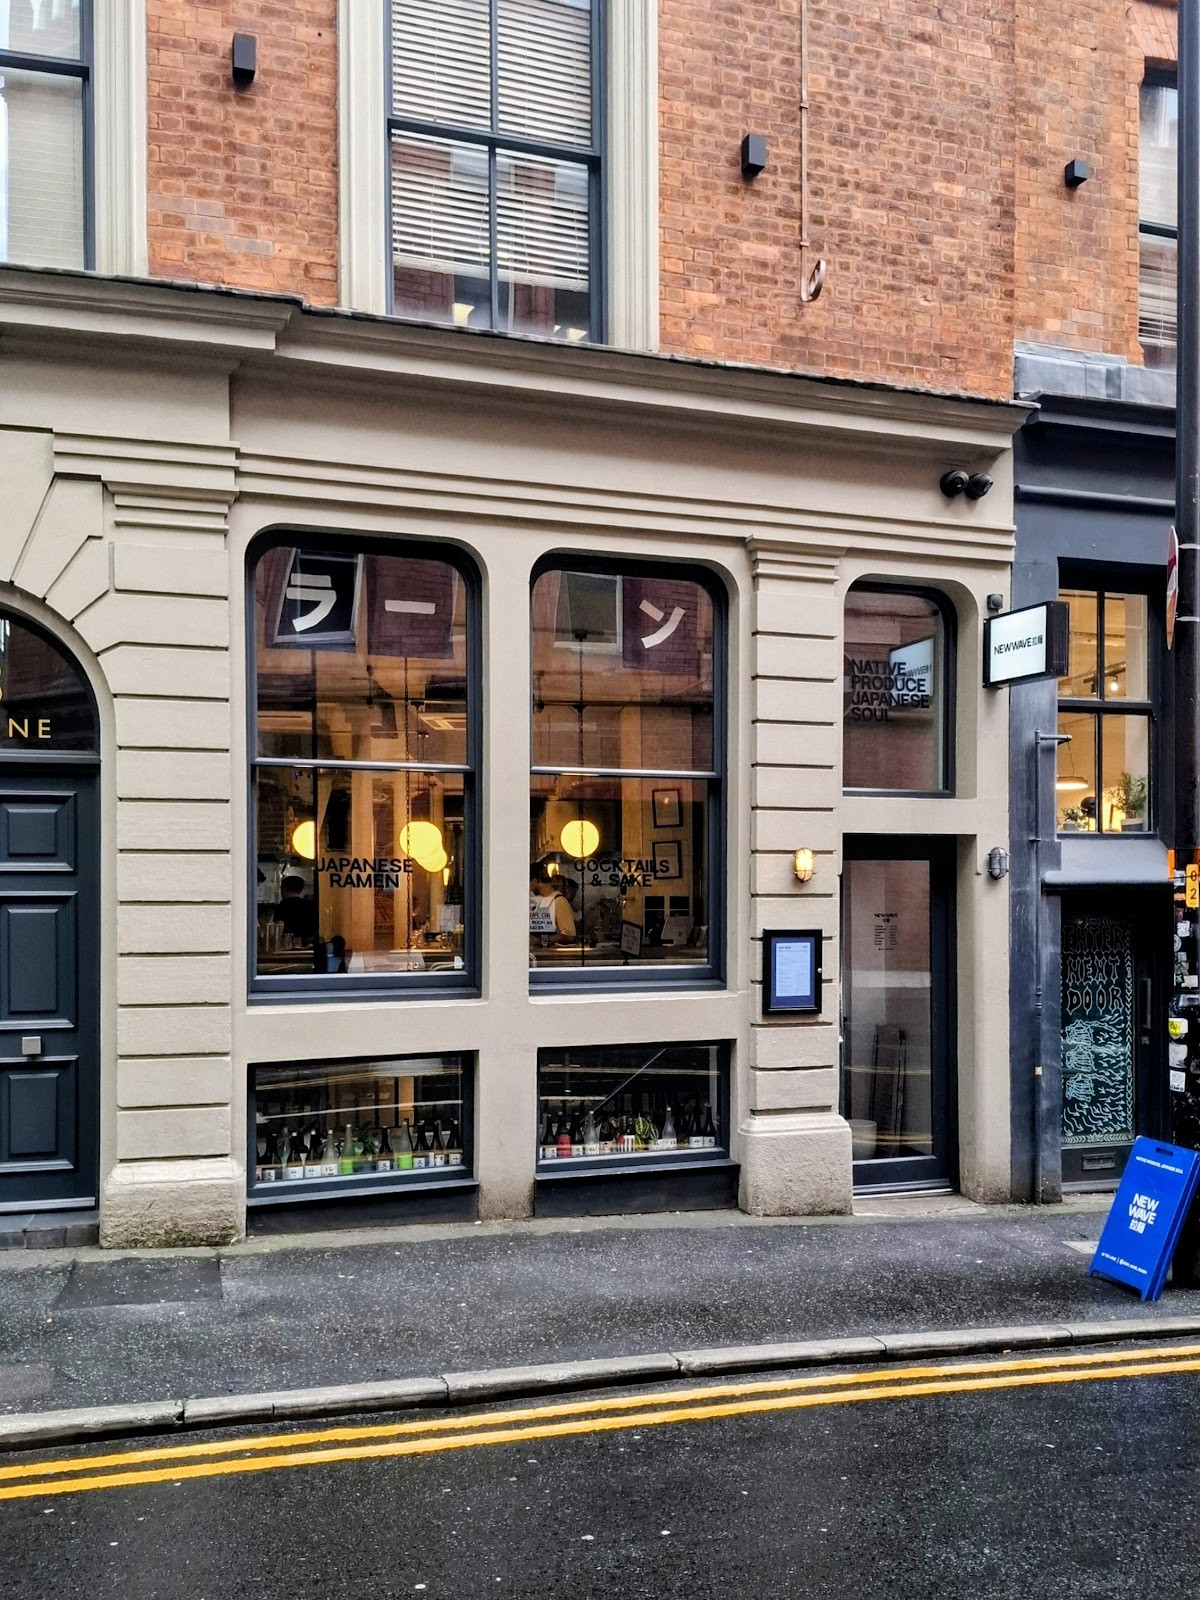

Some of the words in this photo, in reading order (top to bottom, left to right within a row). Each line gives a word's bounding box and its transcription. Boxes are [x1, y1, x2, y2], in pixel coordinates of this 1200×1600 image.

[851, 659, 907, 676] NATIVE
[851, 675, 926, 692] PRODUCE
[852, 692, 930, 708] JAPANESE
[851, 707, 893, 722] SOUL
[317, 858, 413, 873] JAPANESE
[574, 859, 670, 873] COCKTAILS
[330, 873, 399, 888] RAMEN
[591, 874, 602, 886] &
[609, 874, 652, 887] SAKE
[1190, 888, 1197, 900] 2
[1062, 925, 1124, 955] ENTER
[1066, 955, 1120, 987] NEXT
[1066, 984, 1124, 1016] DOOR
[1132, 1193, 1160, 1212] NEW
[1128, 1203, 1157, 1225] WAVE
